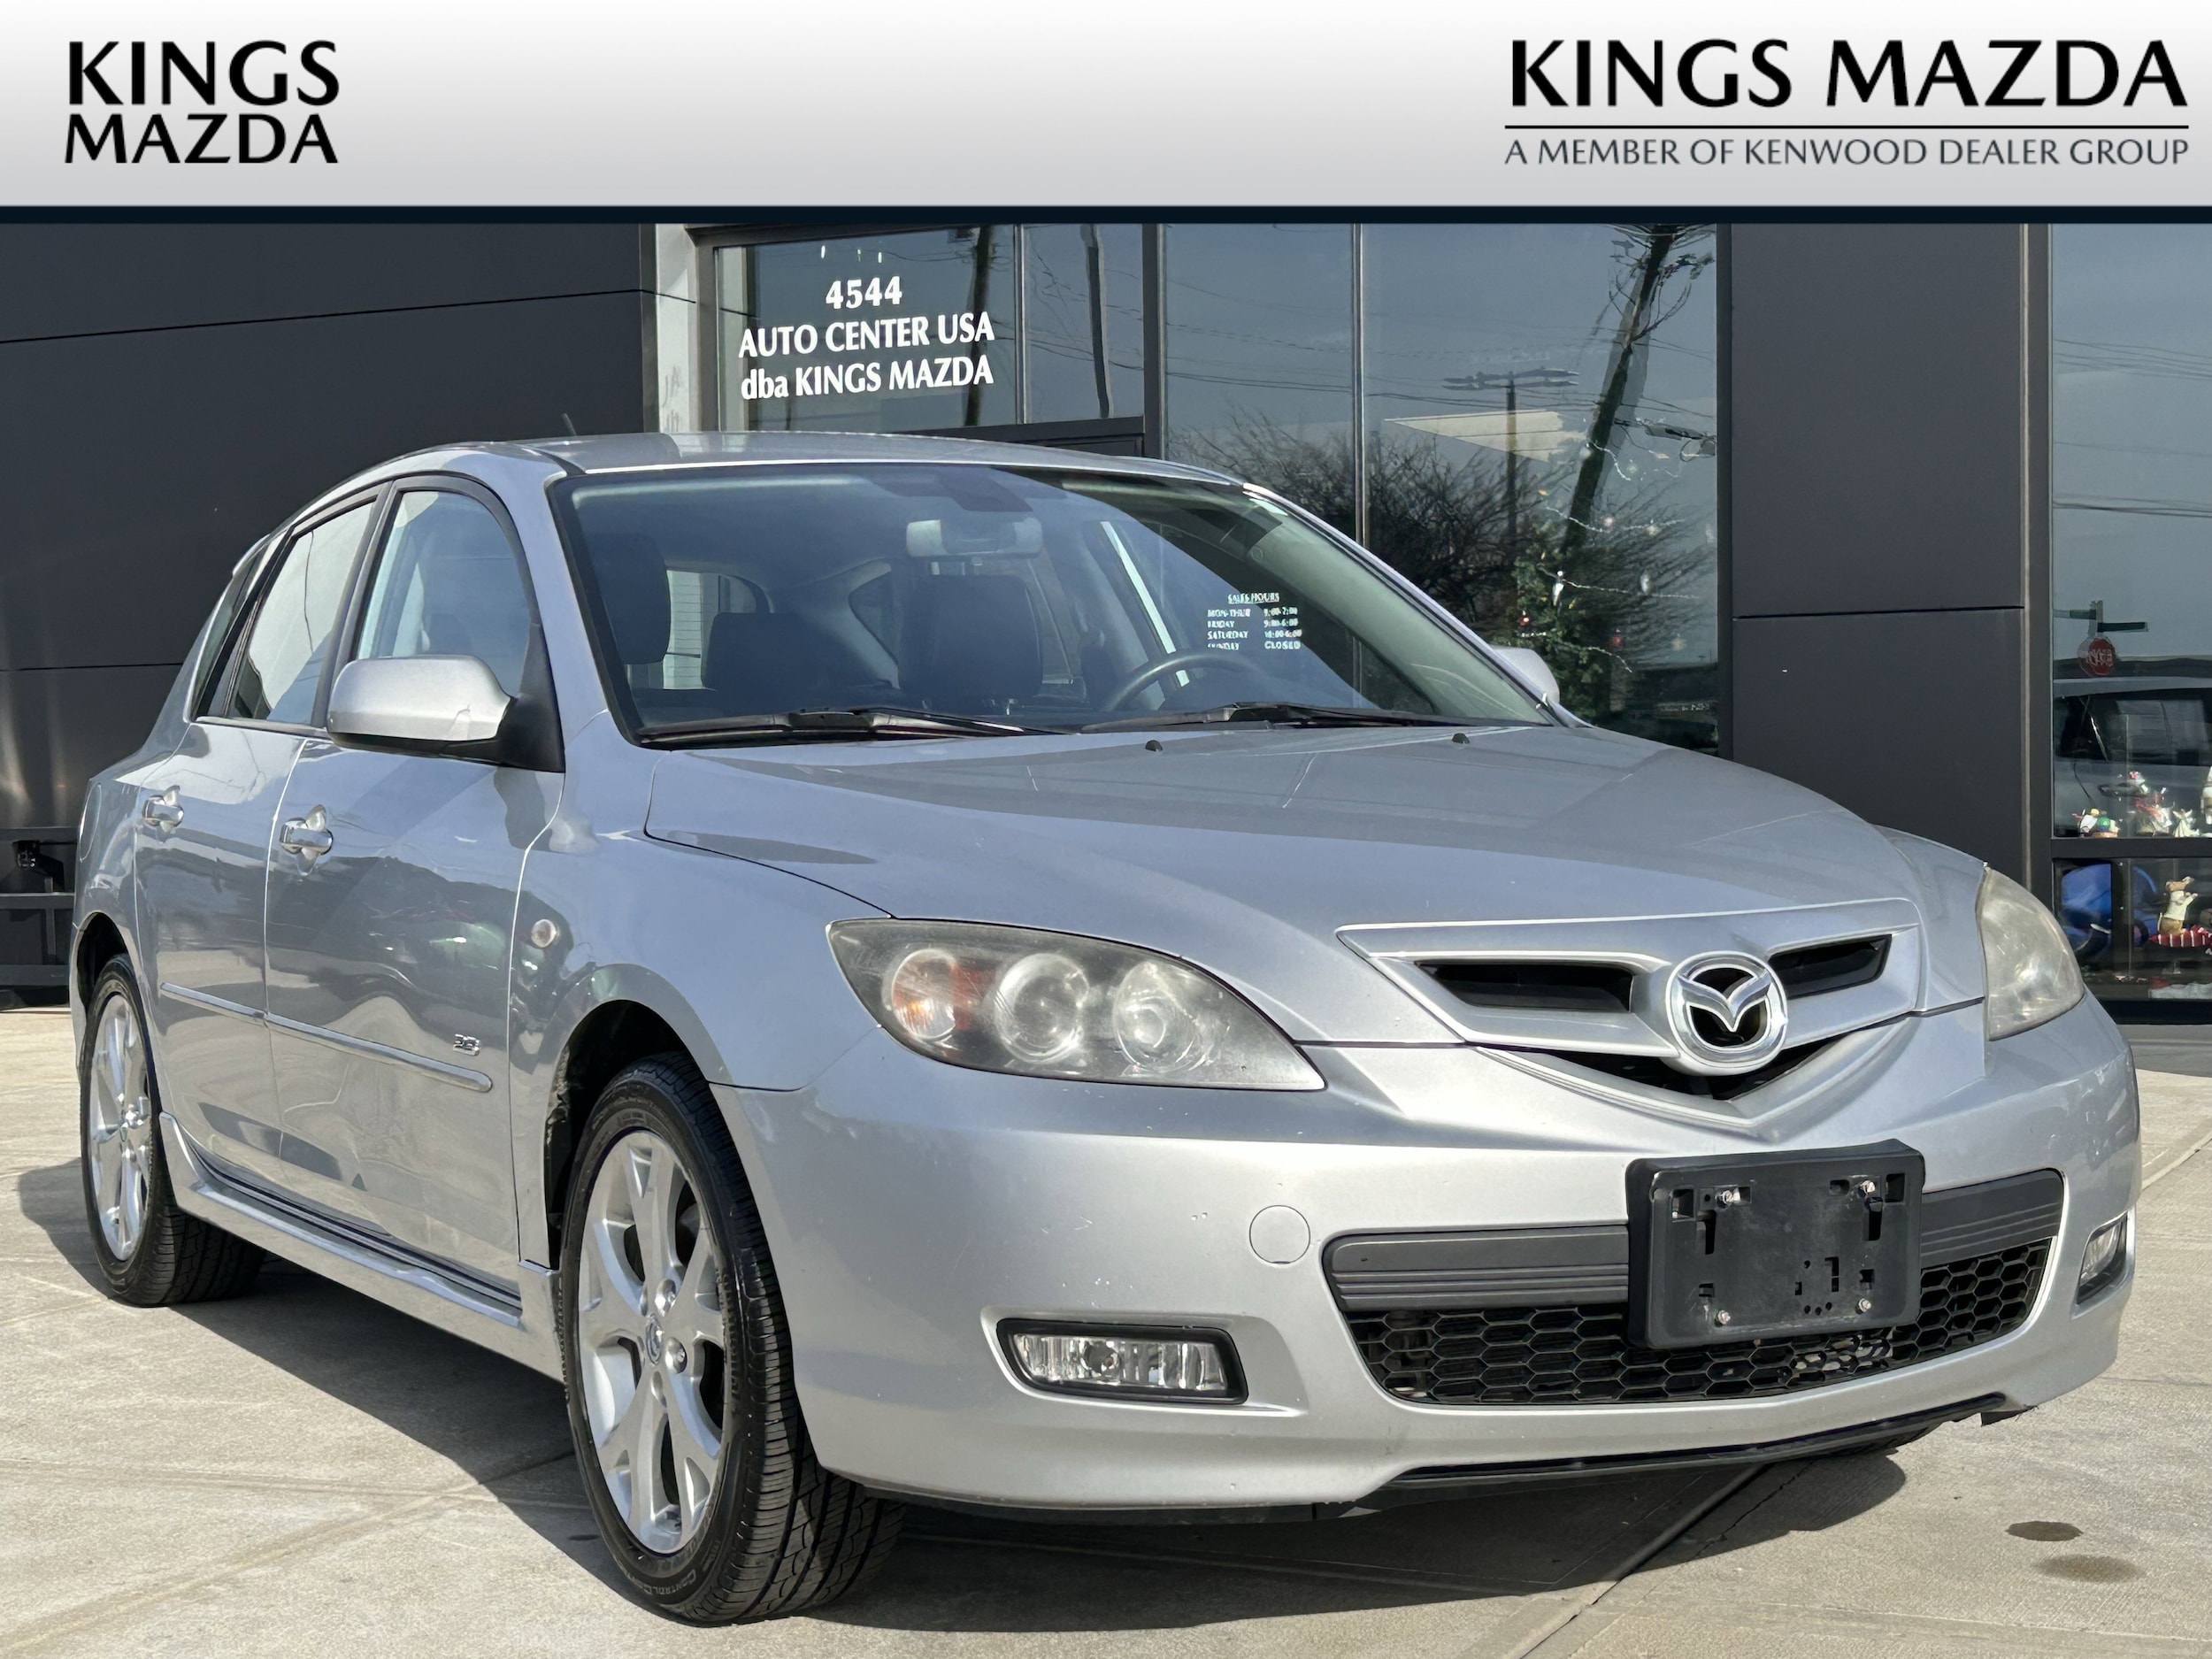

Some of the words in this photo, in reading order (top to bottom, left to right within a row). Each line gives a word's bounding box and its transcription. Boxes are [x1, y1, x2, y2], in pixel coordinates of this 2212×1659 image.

[825, 275, 902, 310] 4544
[738, 324, 818, 358] AUTO
[825, 316, 930, 352] CENTER
[937, 311, 995, 345] USA
[741, 368, 788, 400] dba
[795, 362, 882, 396] KINGS
[888, 354, 995, 390] MAZDA
[1227, 593, 1250, 604] SALES
[1251, 592, 1280, 603] HOURS
[1207, 631, 1248, 641] SATURDAY
[1264, 641, 1302, 650] CLOSED
